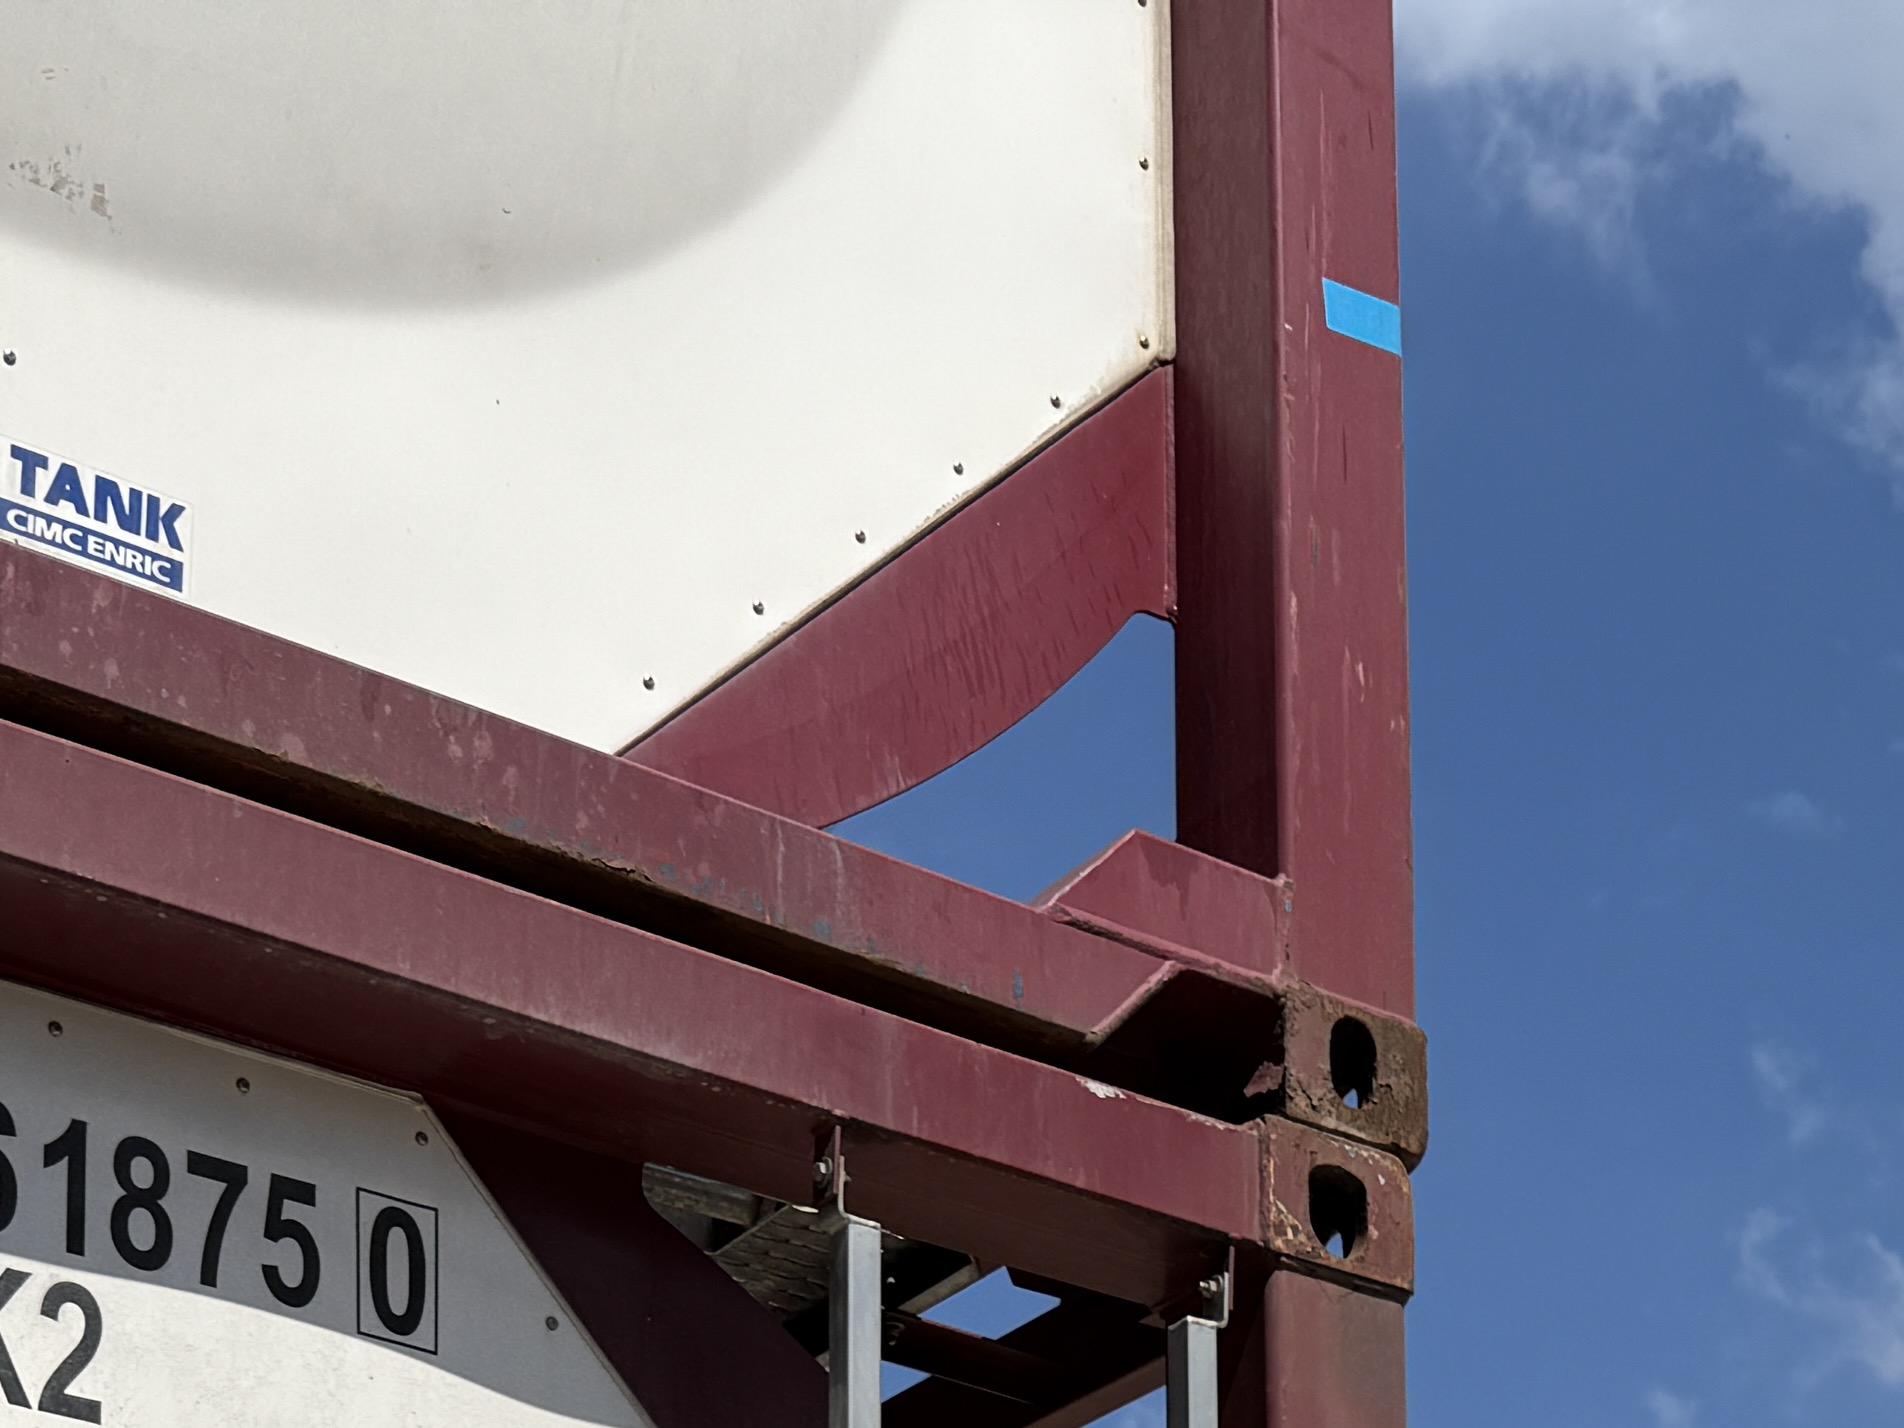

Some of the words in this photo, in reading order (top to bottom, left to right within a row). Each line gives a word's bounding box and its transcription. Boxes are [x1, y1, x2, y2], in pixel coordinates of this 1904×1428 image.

[10, 444, 185, 552] TANK
[7, 509, 83, 552] CIMC
[86, 533, 172, 584] ENRIC
